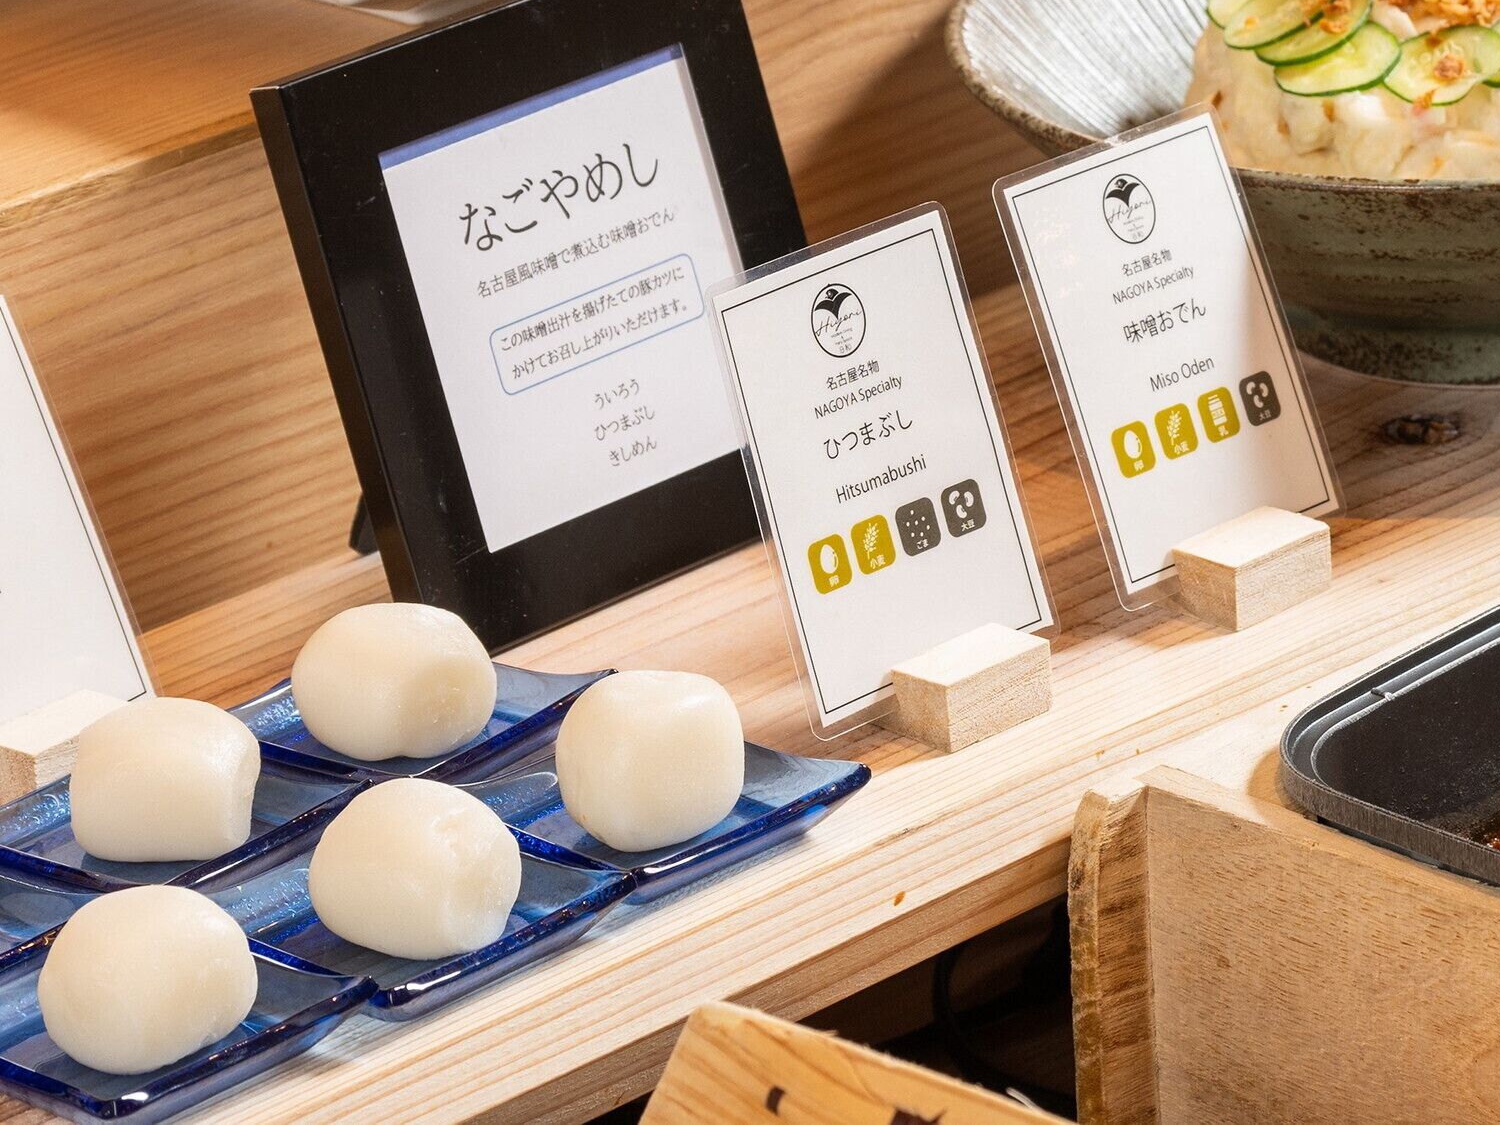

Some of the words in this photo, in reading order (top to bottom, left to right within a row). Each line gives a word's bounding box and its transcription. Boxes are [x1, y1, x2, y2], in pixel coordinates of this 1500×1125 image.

[459, 143, 658, 251] なごやめし
[477, 208, 675, 299] 名古屋風味噌で煮込む味噌おでん
[1122, 249, 1173, 277] 名古屋名物
[1112, 279, 1154, 305] NAGOYA
[1155, 266, 1194, 290] Specialty
[512, 298, 687, 379] かけてお召し上がりいただけます。
[1123, 298, 1206, 343] 味噌おでん
[594, 378, 640, 409] ういろう
[826, 359, 880, 391] 名古屋名物
[1150, 371, 1180, 392] Miso
[1180, 357, 1215, 379] Oden
[814, 392, 858, 419] NAGOYA
[859, 376, 902, 402] Specialty
[593, 405, 655, 441] ひつまぶし
[823, 410, 913, 460] ひつまぶし
[609, 436, 657, 467] きしめん
[836, 453, 927, 504] Hitsumabushi
[916, 537, 930, 551] ごま
